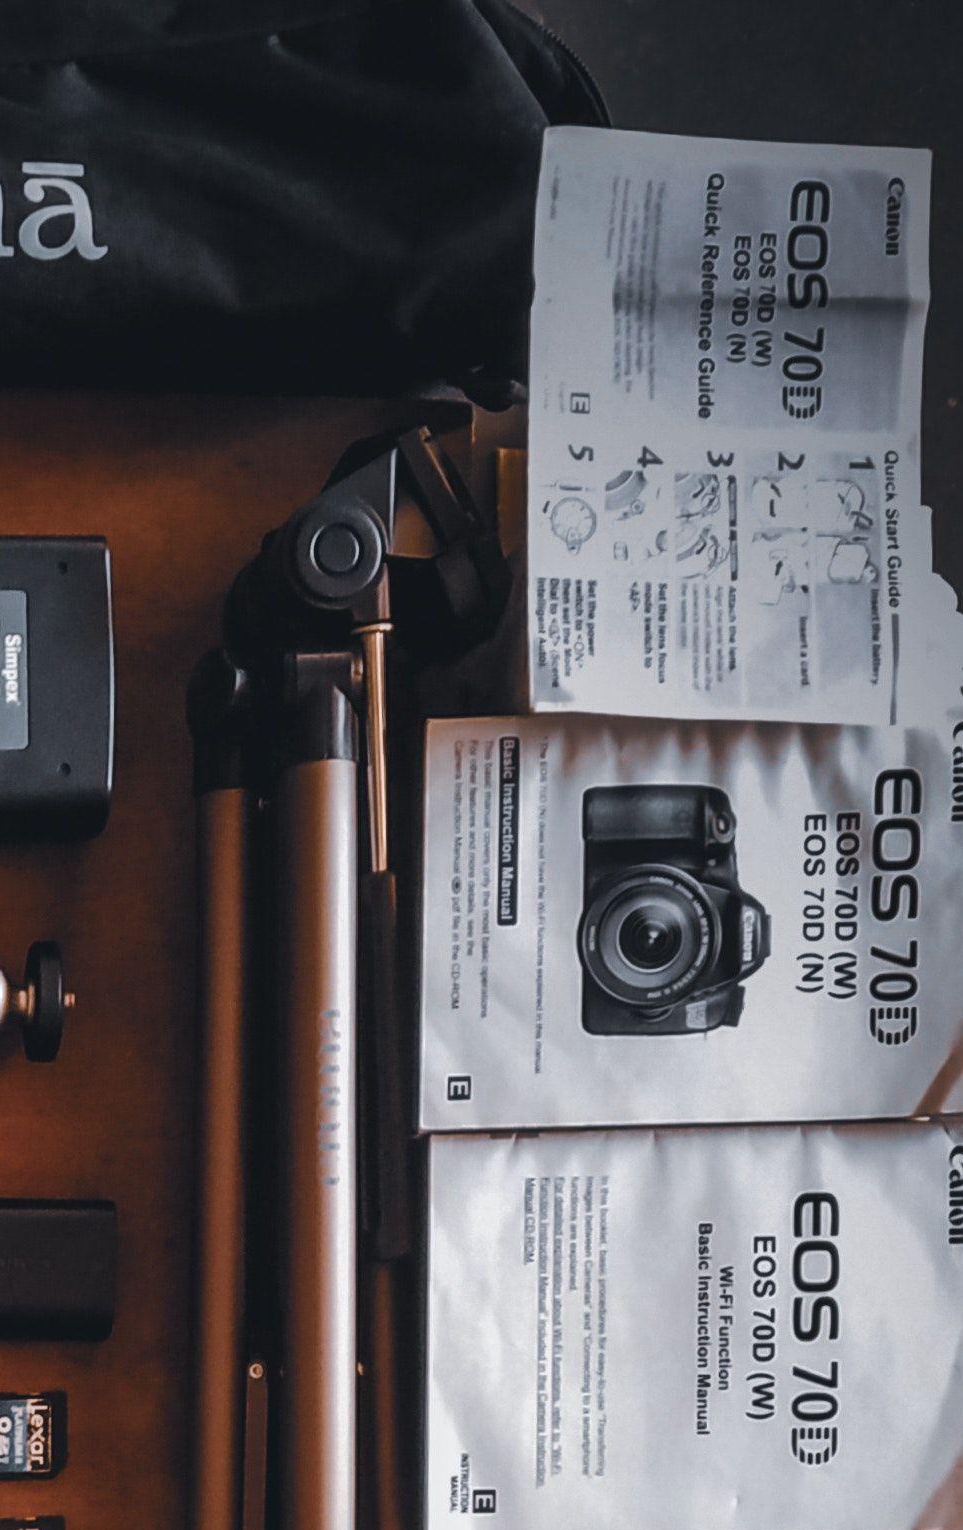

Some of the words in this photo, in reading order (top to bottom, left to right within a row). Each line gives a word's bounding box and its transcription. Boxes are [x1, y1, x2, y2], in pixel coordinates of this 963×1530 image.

[704, 173, 725, 236] Quick
[886, 178, 905, 256] Canon
[733, 236, 751, 280] EOS
[758, 233, 776, 278] EOS
[787, 181, 830, 309] EOS
[697, 245, 720, 350] Reference
[731, 287, 750, 326] 70D
[757, 286, 776, 323] 70D
[726, 333, 746, 363] (N)
[751, 330, 772, 366] (W)
[698, 358, 715, 418] Guide
[782, 327, 824, 419] 70D
[569, 444, 593, 461] 5
[638, 446, 663, 468] 4
[707, 451, 734, 468] 3
[778, 452, 805, 471] 2
[850, 456, 875, 470] 1
[885, 450, 900, 501] Quick
[886, 508, 901, 549] Start
[550, 578, 559, 600] Dial
[563, 578, 572, 603] then
[575, 579, 584, 616] switch
[588, 580, 597, 598] Set
[644, 582, 653, 613] mode
[658, 583, 668, 601] Set
[887, 556, 901, 607] Guide
[536, 577, 547, 634] Intelligent
[550, 604, 559, 615] to
[563, 607, 571, 624] set
[575, 620, 584, 631] to
[588, 601, 597, 619] the
[658, 604, 668, 622] the
[563, 627, 571, 645] the
[586, 623, 596, 656] power
[644, 617, 653, 654] switch
[658, 626, 668, 649] lens
[1, 634, 22, 704] Simpex
[564, 648, 572, 677] Mode
[644, 657, 653, 669] to
[658, 653, 668, 684] focus
[503, 739, 516, 779] Basic
[501, 783, 515, 862] Instruction
[835, 812, 859, 876] EOS
[802, 814, 826, 876] EOS
[870, 768, 922, 922] EOS
[500, 867, 514, 920] Manual
[802, 888, 825, 942] 70D
[834, 886, 859, 942] 70D
[742, 911, 755, 961] Canon
[796, 952, 825, 994] (N)
[828, 951, 859, 1000] (W)
[869, 940, 918, 1045] 70D
[697, 1223, 712, 1270] Basic
[752, 1236, 775, 1297] EOS
[792, 1191, 839, 1342] EOS
[718, 1266, 734, 1310] Wi-Fi
[696, 1276, 712, 1369] Instruction
[752, 1308, 775, 1363] 70D
[717, 1315, 733, 1391] Function
[696, 1374, 711, 1435] Manual
[746, 1373, 775, 1421] (W)
[791, 1361, 838, 1465] 70D
[28, 1404, 47, 1465] Lexar
[450, 1476, 458, 1512] MANUAL
[460, 1453, 469, 1513] INSTRUCTION
